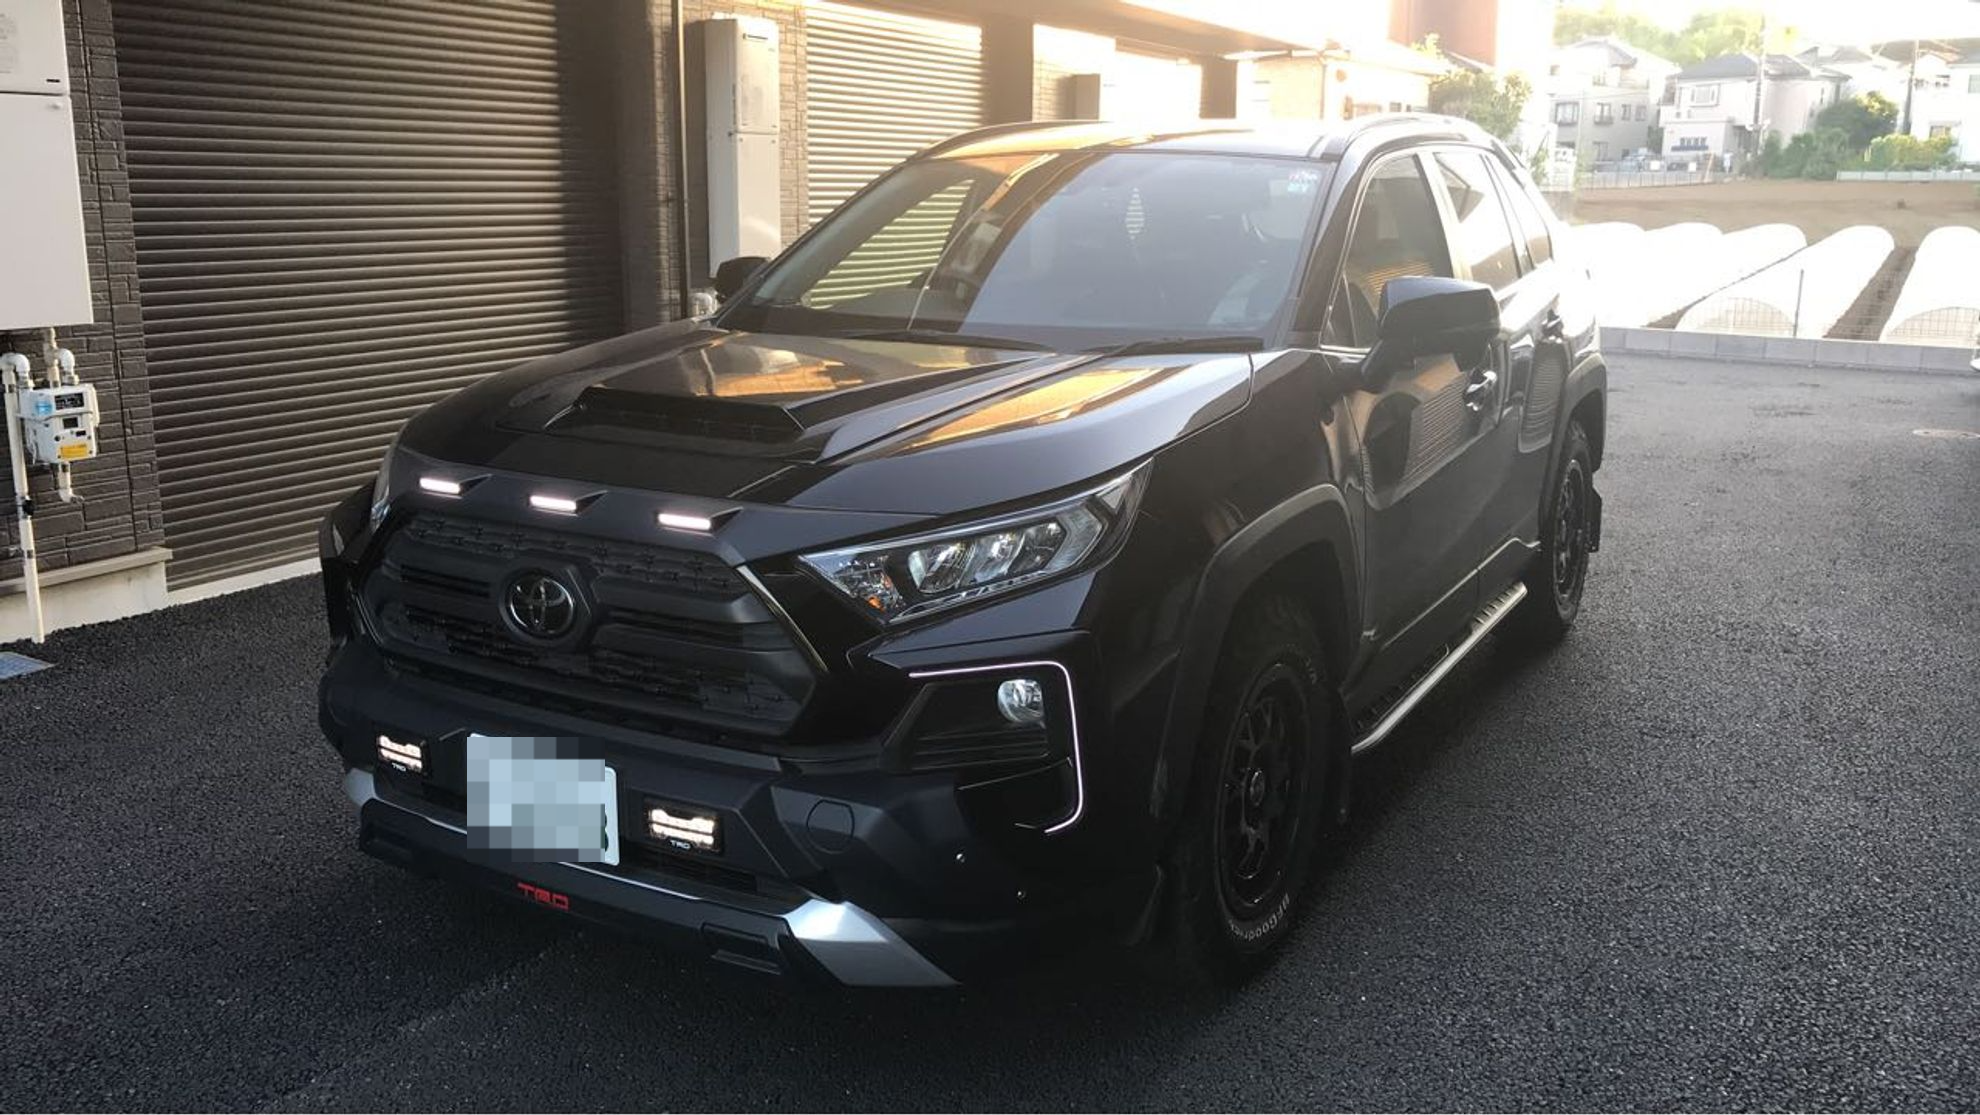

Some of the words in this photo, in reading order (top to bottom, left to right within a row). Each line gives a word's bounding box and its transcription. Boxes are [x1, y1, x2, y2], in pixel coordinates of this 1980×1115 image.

[391, 762, 406, 772] TRD
[669, 839, 691, 849] TRD
[517, 882, 569, 908] TRD
